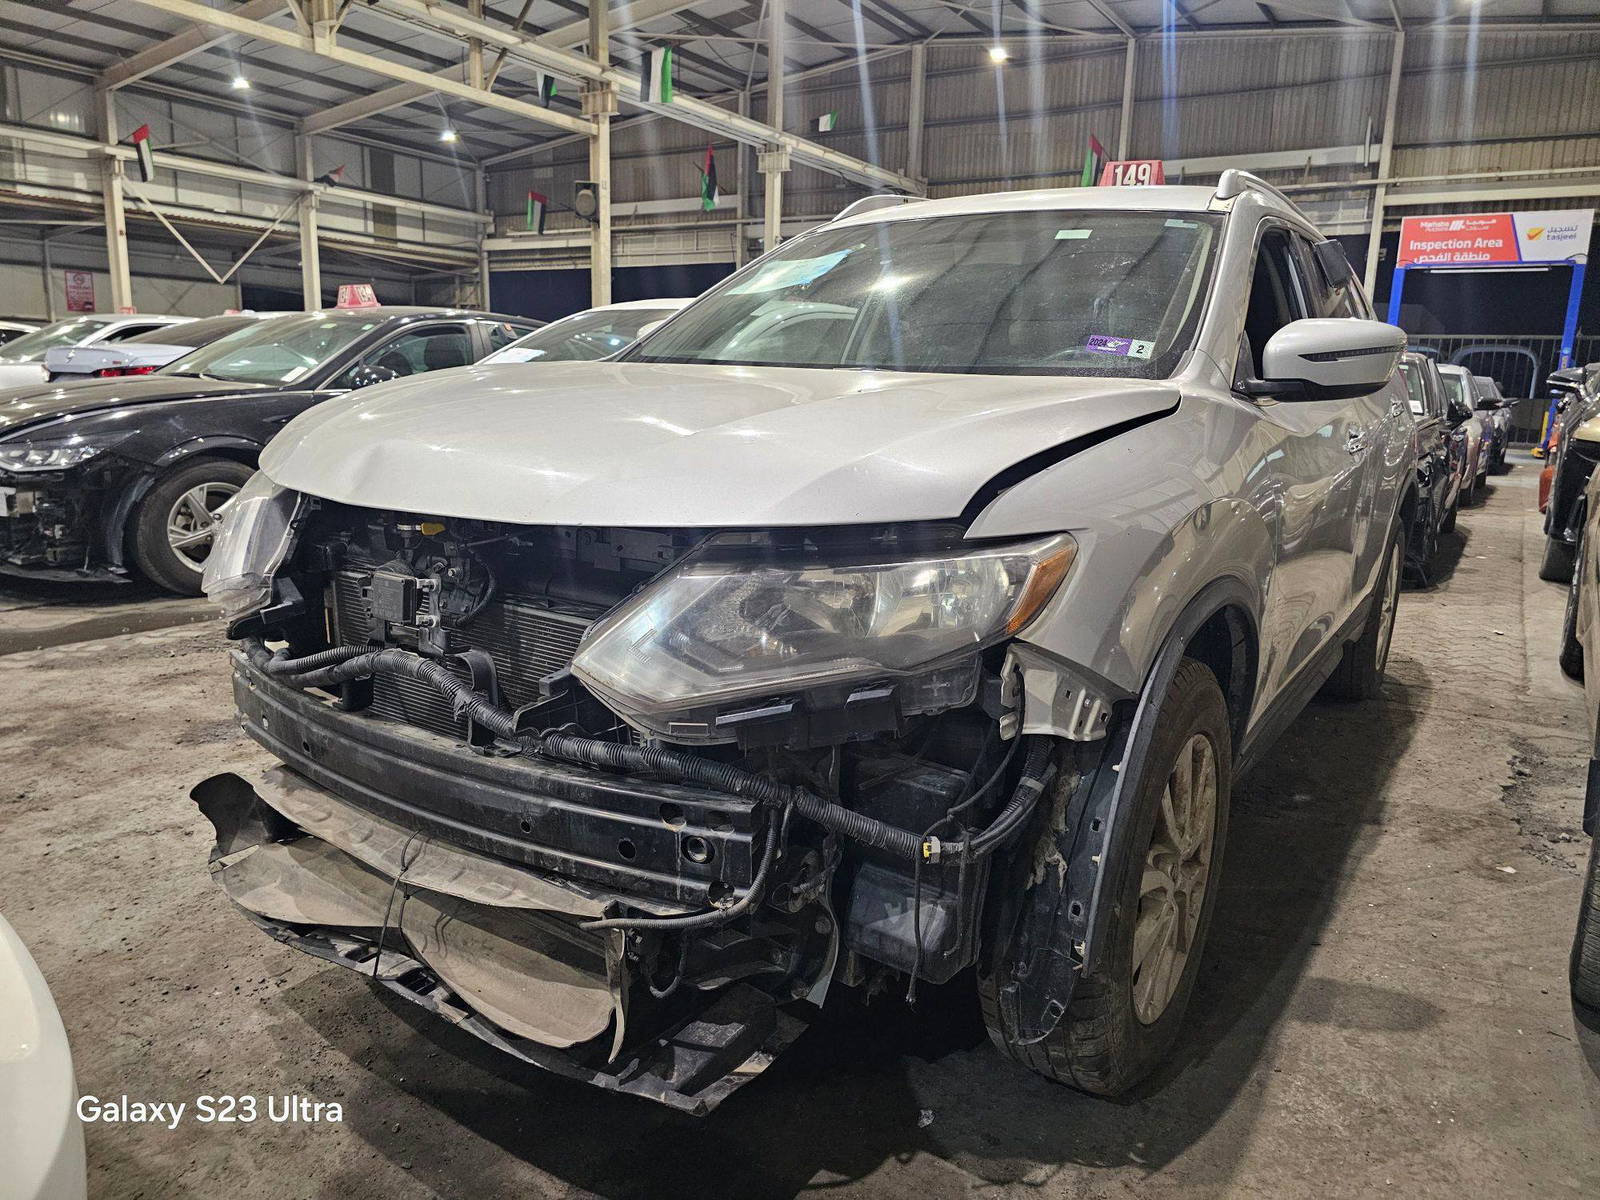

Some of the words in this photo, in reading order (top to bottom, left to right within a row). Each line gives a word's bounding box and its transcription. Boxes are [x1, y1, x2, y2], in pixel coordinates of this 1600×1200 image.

[1114, 163, 1151, 187] 149
[1546, 233, 1577, 241] tasjeel
[1409, 239, 1472, 252] Inspection
[1474, 238, 1504, 248] Area
[1137, 345, 1145, 354] 2
